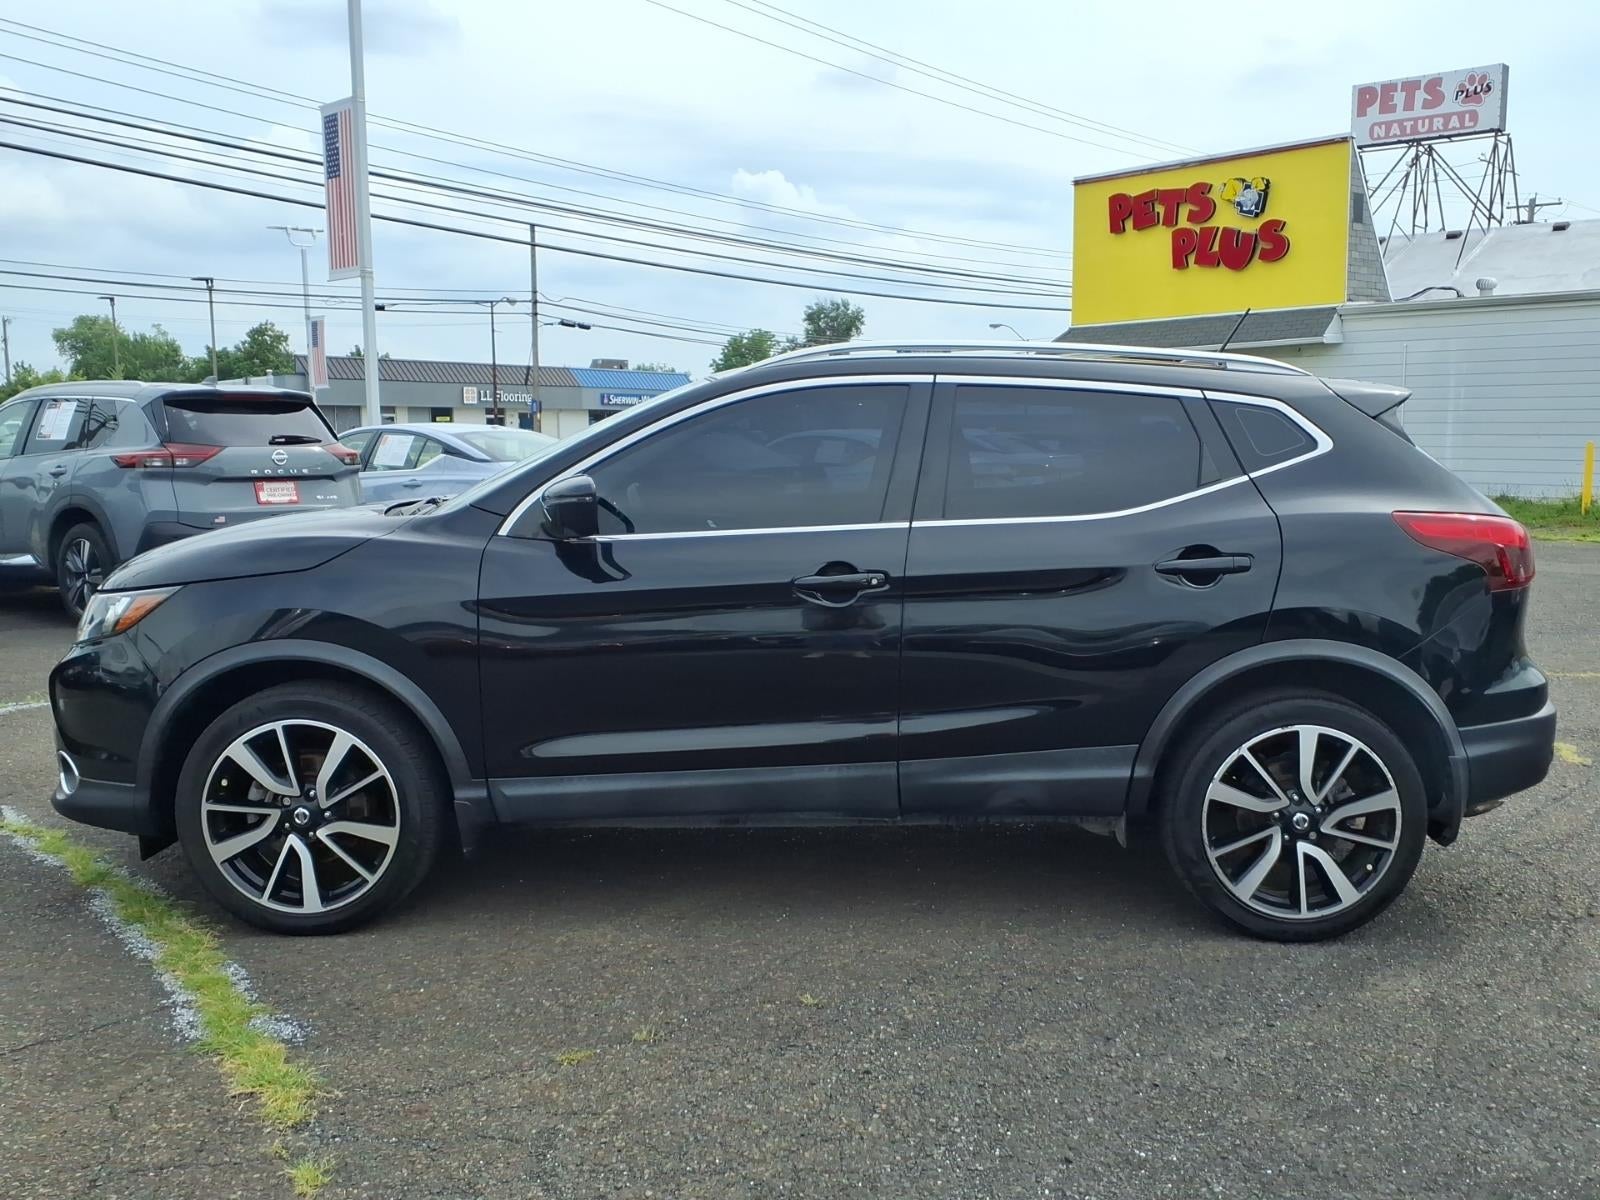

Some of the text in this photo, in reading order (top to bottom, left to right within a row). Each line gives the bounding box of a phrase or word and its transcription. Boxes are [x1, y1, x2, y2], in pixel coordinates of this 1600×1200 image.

[1356, 77, 1493, 118] PETS PLUS
[1373, 113, 1475, 138] NATURAL
[1108, 182, 1217, 235] PETS
[1171, 219, 1291, 272] PLUS
[480, 389, 533, 405] LL Flooring
